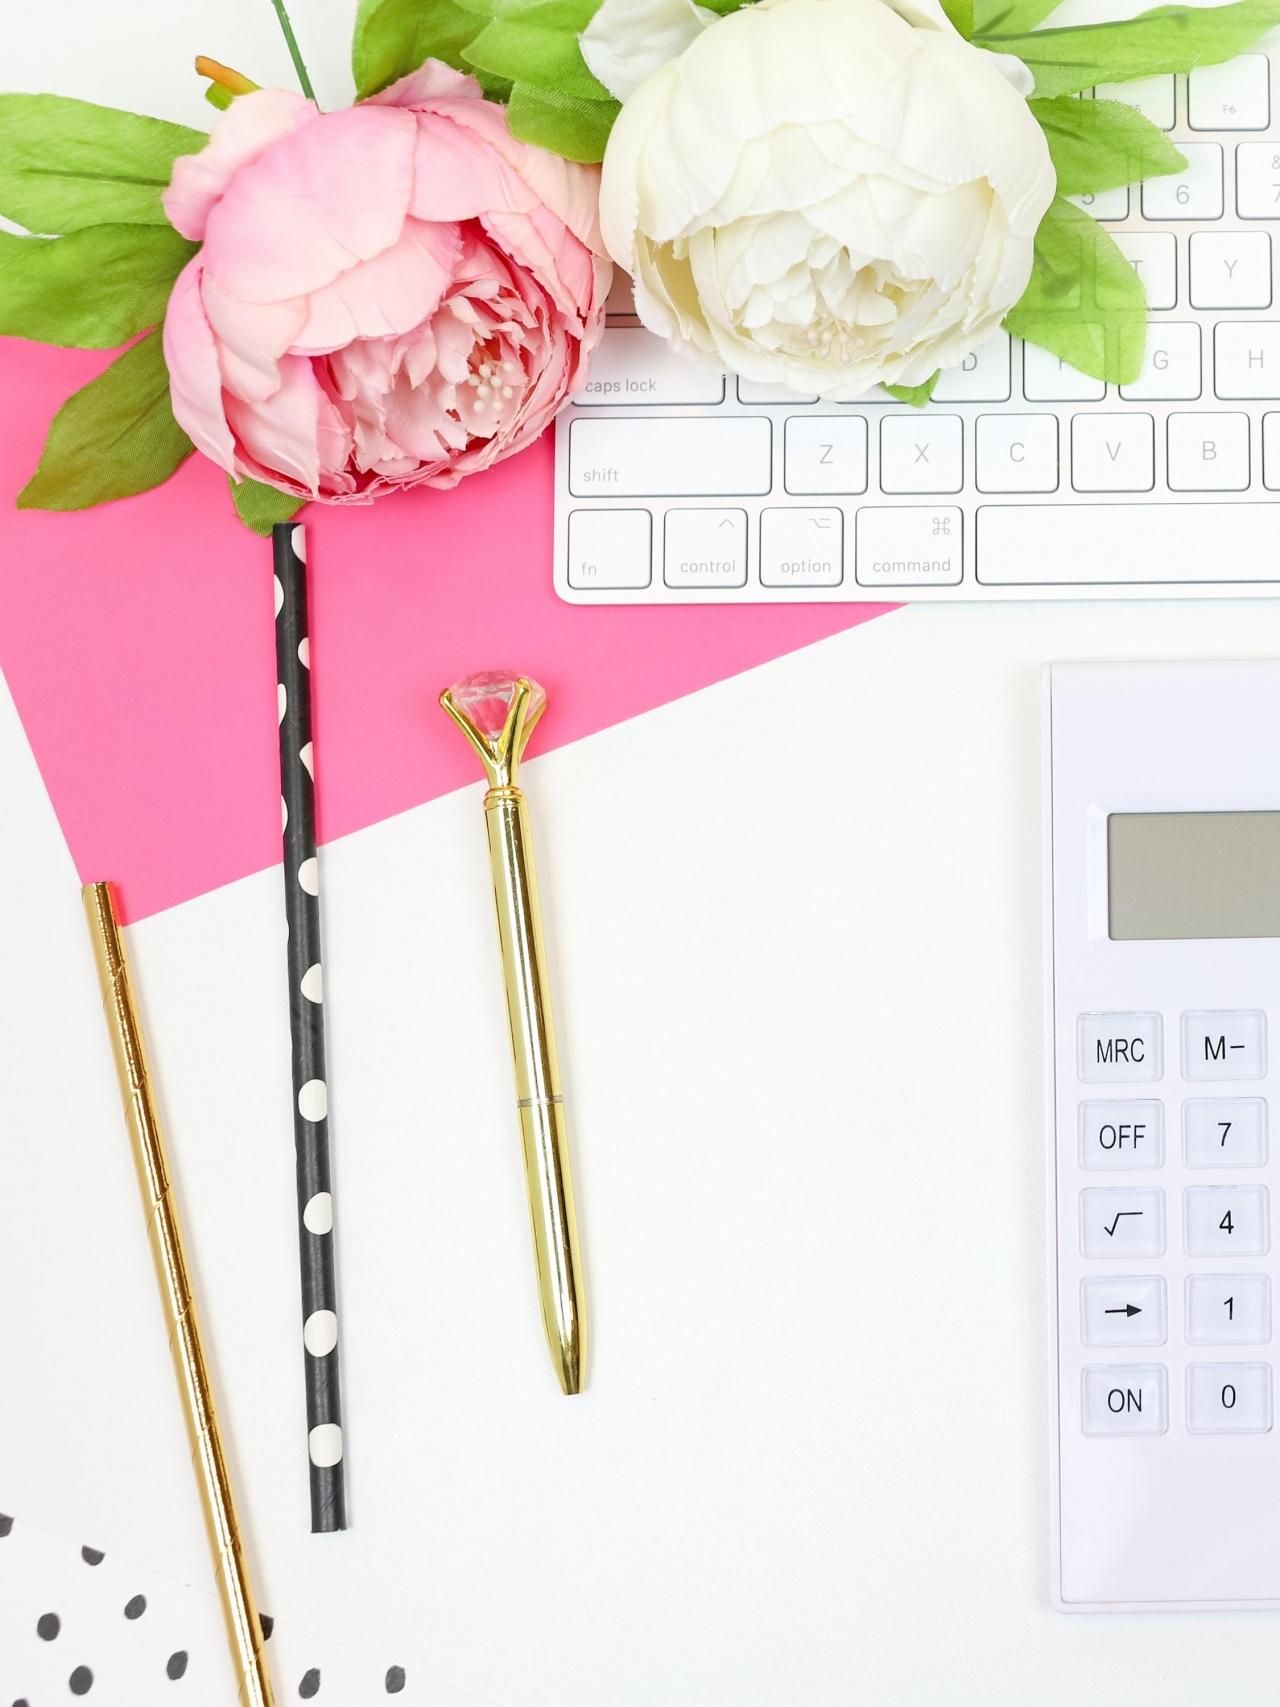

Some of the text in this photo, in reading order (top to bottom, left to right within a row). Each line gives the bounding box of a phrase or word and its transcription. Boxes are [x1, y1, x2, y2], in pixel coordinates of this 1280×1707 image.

[1222, 104, 1237, 115] F6
[1175, 184, 1190, 205] 6
[1223, 258, 1238, 280] Y
[962, 352, 977, 371] D
[1152, 349, 1169, 371] G
[1248, 349, 1264, 369] H
[585, 377, 657, 395] caps lock
[819, 444, 834, 465] Z
[914, 443, 930, 464] X
[1009, 441, 1025, 463] C
[1105, 441, 1122, 462] V
[1202, 440, 1217, 461] B
[583, 468, 619, 483] shift
[581, 561, 597, 577] fn
[680, 559, 736, 574] control
[780, 559, 831, 576] option
[872, 557, 952, 573] command
[1096, 1037, 1145, 1064] MRC
[1204, 1035, 1246, 1061] M-
[1099, 1124, 1146, 1150] OFF
[1217, 1122, 1232, 1147] 7
[1218, 1210, 1235, 1235] 4
[1223, 1296, 1234, 1321] 1
[1107, 1388, 1142, 1413] ON
[1221, 1384, 1236, 1409] 0
